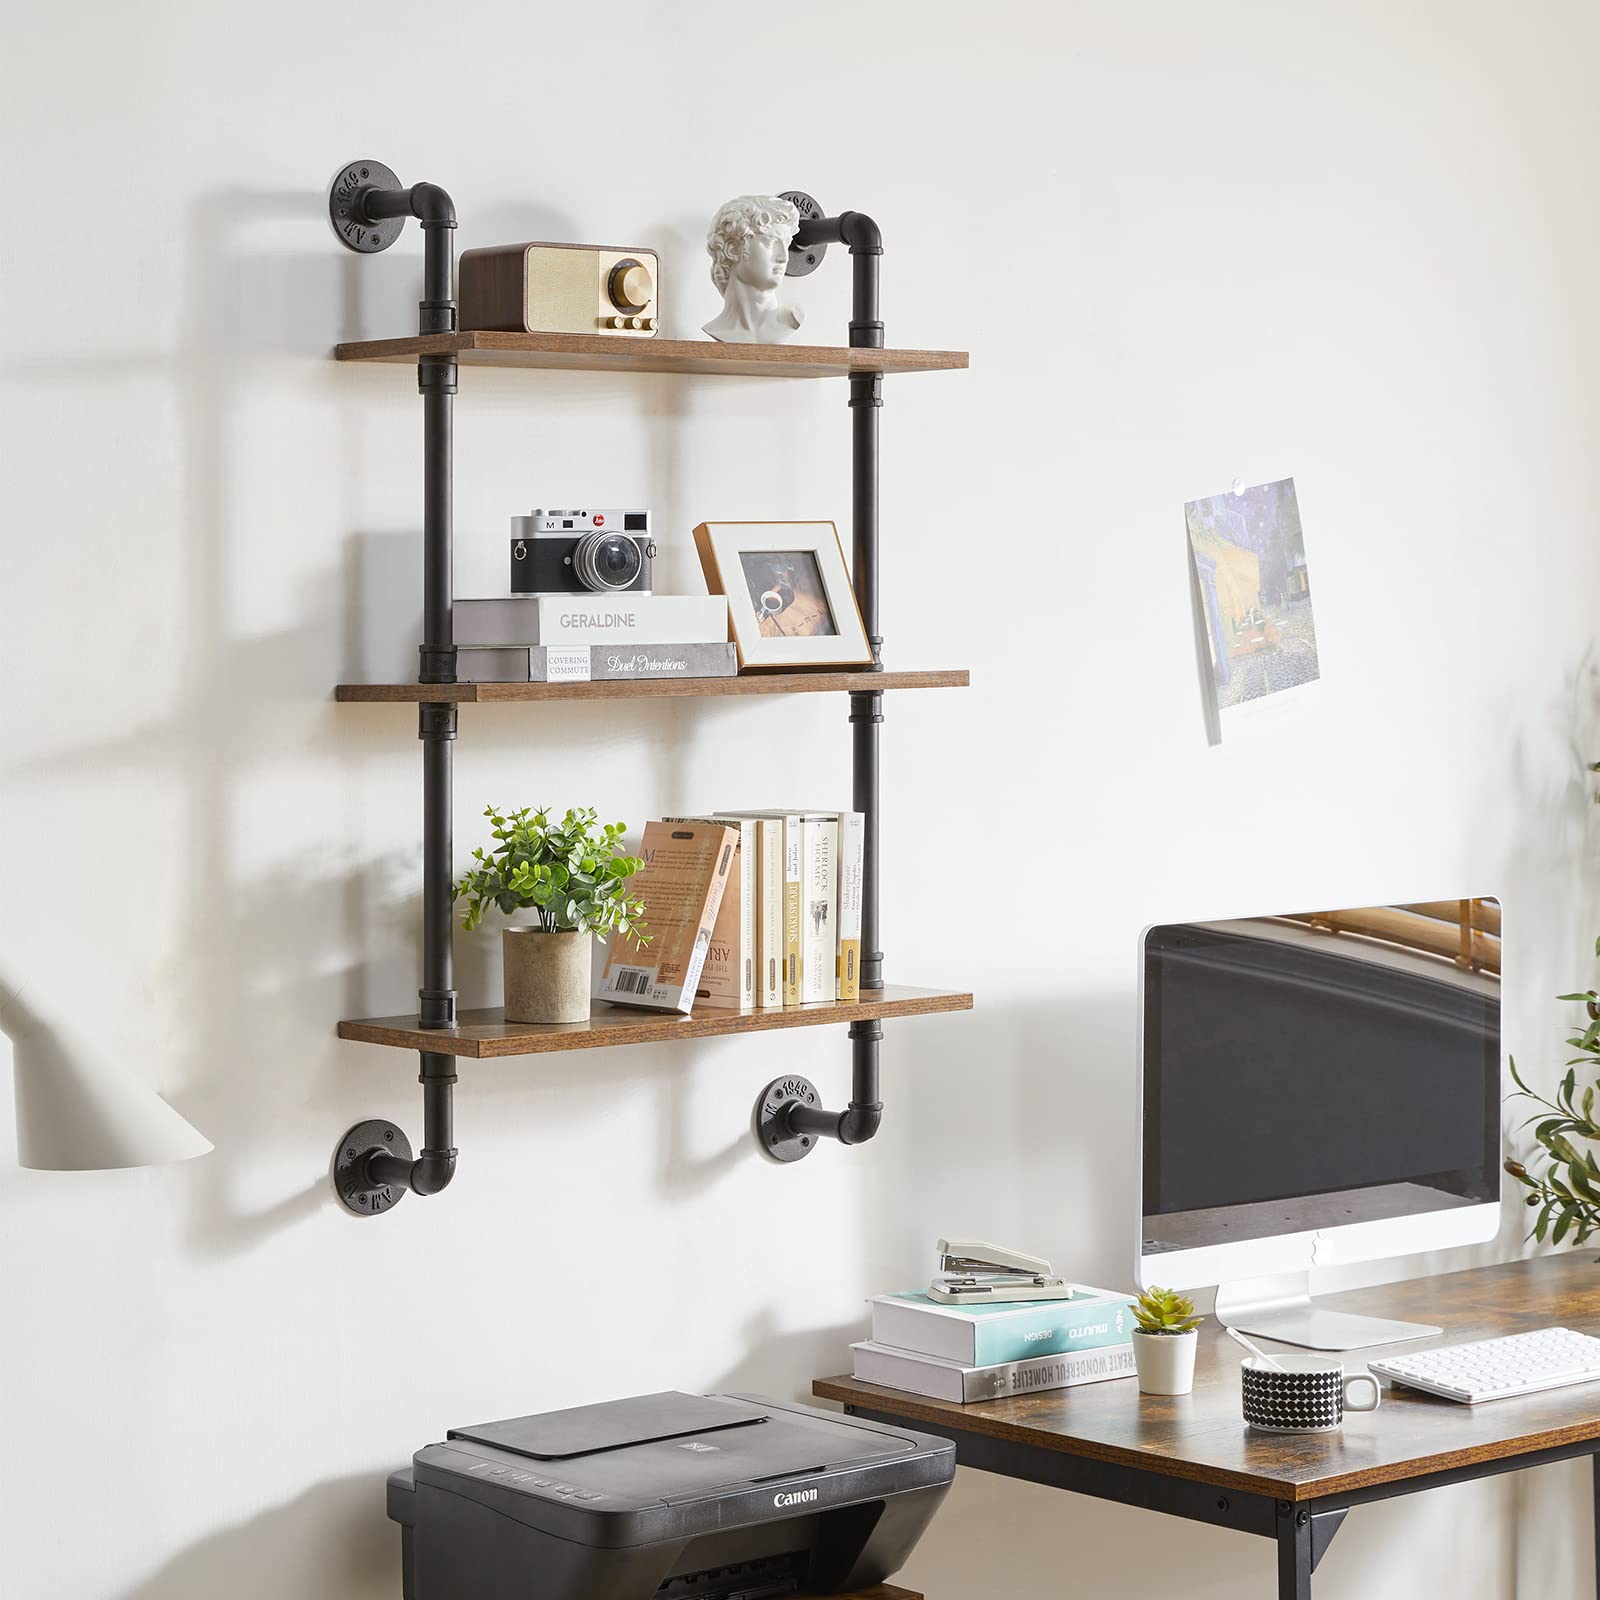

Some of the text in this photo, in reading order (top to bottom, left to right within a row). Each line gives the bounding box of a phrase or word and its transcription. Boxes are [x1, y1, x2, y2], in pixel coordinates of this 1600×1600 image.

[337, 170, 359, 203] 1949
[560, 614, 635, 628] GERALDINE
[548, 656, 588, 665] COVERING
[607, 654, 688, 673] Duel Intentions
[550, 666, 589, 675] COMMUTE
[814, 843, 822, 887] HOLMES
[821, 836, 829, 892] SHERLOCK
[789, 883, 799, 943] SHAKESPEARE
[706, 947, 731, 961] ARI
[783, 1080, 807, 1098] 1949
[1024, 1330, 1053, 1342] DESIGN
[1011, 1367, 1053, 1390] HOMELIFE
[1056, 1357, 1108, 1381] WONDERFUL
[773, 1488, 818, 1507] Canon
